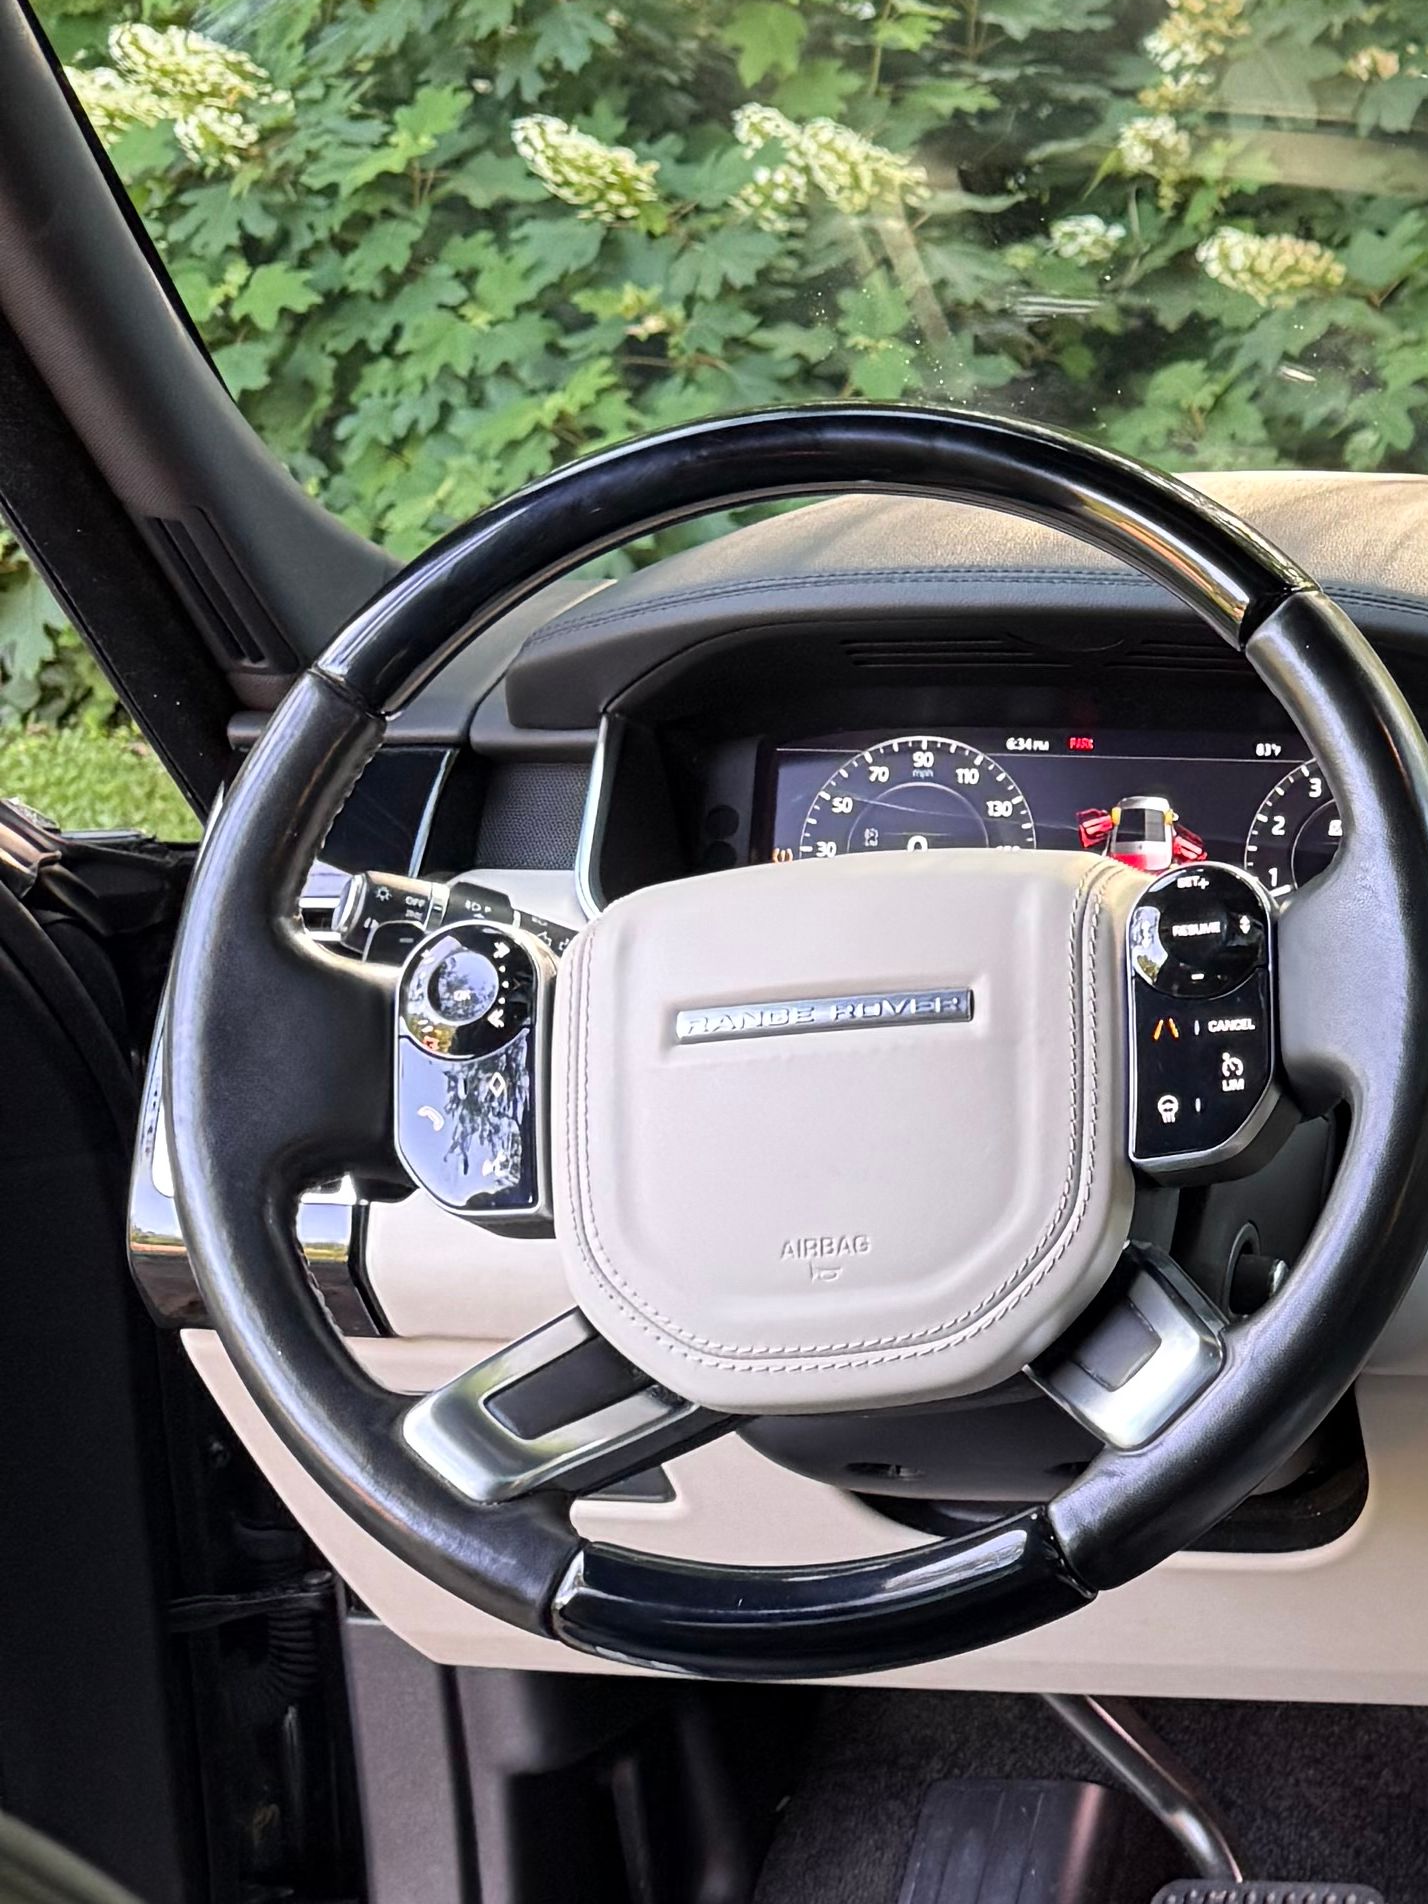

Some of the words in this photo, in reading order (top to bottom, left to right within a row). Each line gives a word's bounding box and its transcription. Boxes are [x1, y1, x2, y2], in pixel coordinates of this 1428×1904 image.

[1006, 737, 1032, 751] 6:34
[912, 752, 935, 768] 90
[868, 765, 890, 783] 70
[912, 768, 934, 780] mph
[956, 768, 980, 785] 110
[1307, 777, 1322, 798] 3
[831, 796, 853, 814] 50
[986, 800, 1013, 817] 130
[1270, 815, 1286, 836] 2
[815, 840, 837, 858] 30
[1268, 867, 1278, 887] 1
[1172, 921, 1221, 937] RESUME
[686, 1006, 816, 1035] RANGE
[830, 996, 961, 1022] ROVER
[1207, 1018, 1256, 1034] CANCEL
[780, 1234, 872, 1260] AIRBAG
